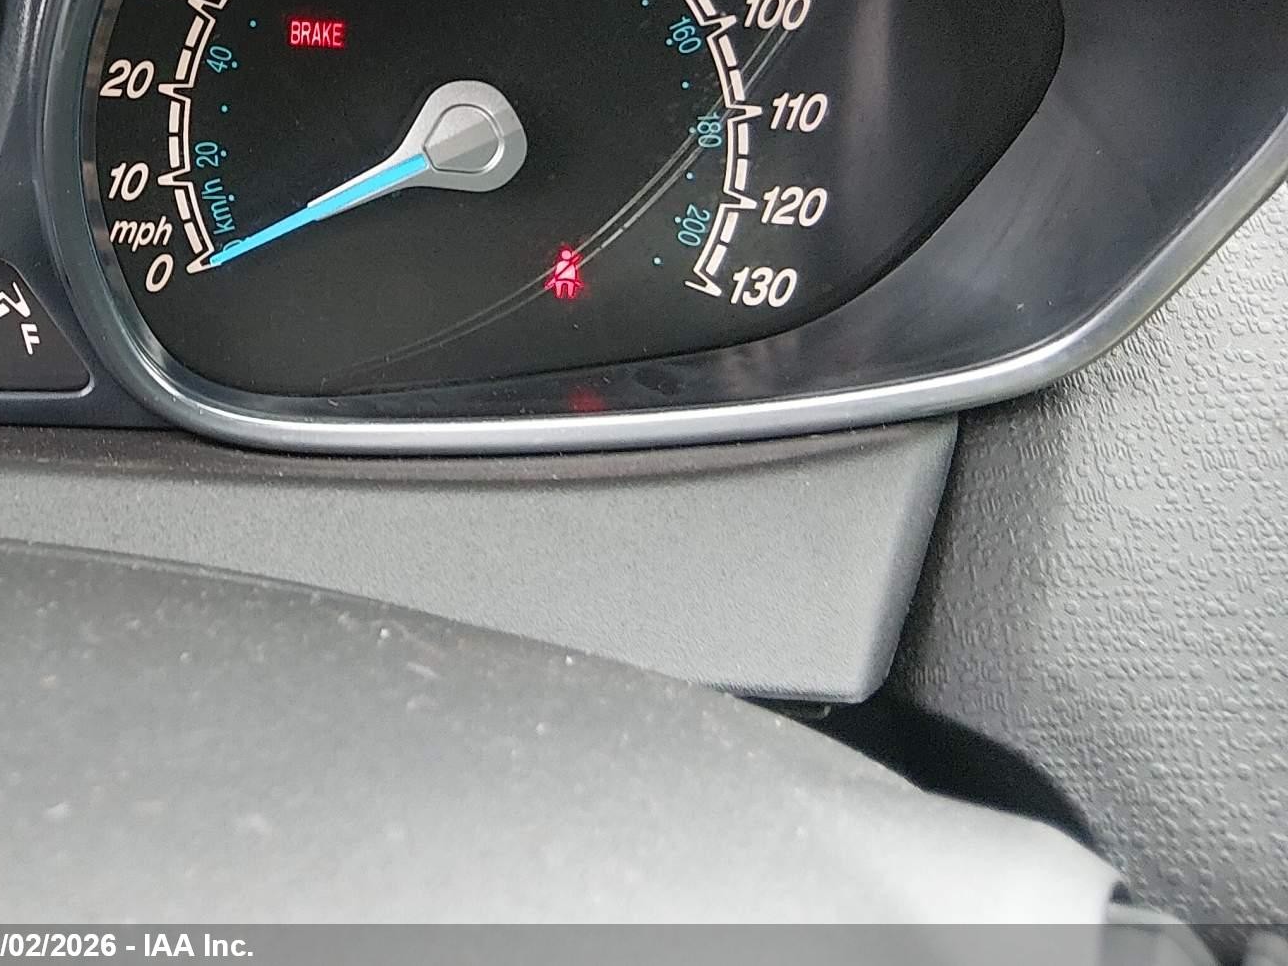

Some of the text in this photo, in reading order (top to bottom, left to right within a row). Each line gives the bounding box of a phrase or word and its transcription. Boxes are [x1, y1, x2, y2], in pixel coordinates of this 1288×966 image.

[290, 22, 344, 48] BRAKE
[669, 16, 702, 53] 160
[206, 45, 231, 73] 40
[101, 59, 154, 99] 20
[697, 112, 721, 148] 180
[770, 93, 828, 132] 110
[194, 141, 219, 168] 20
[108, 164, 148, 199] 10
[201, 177, 236, 235] km/h
[761, 188, 827, 226] 120
[110, 218, 173, 250] mph
[677, 205, 710, 247] 200
[146, 256, 172, 293] 0
[731, 268, 796, 307] 130
[21, 324, 40, 355] F
